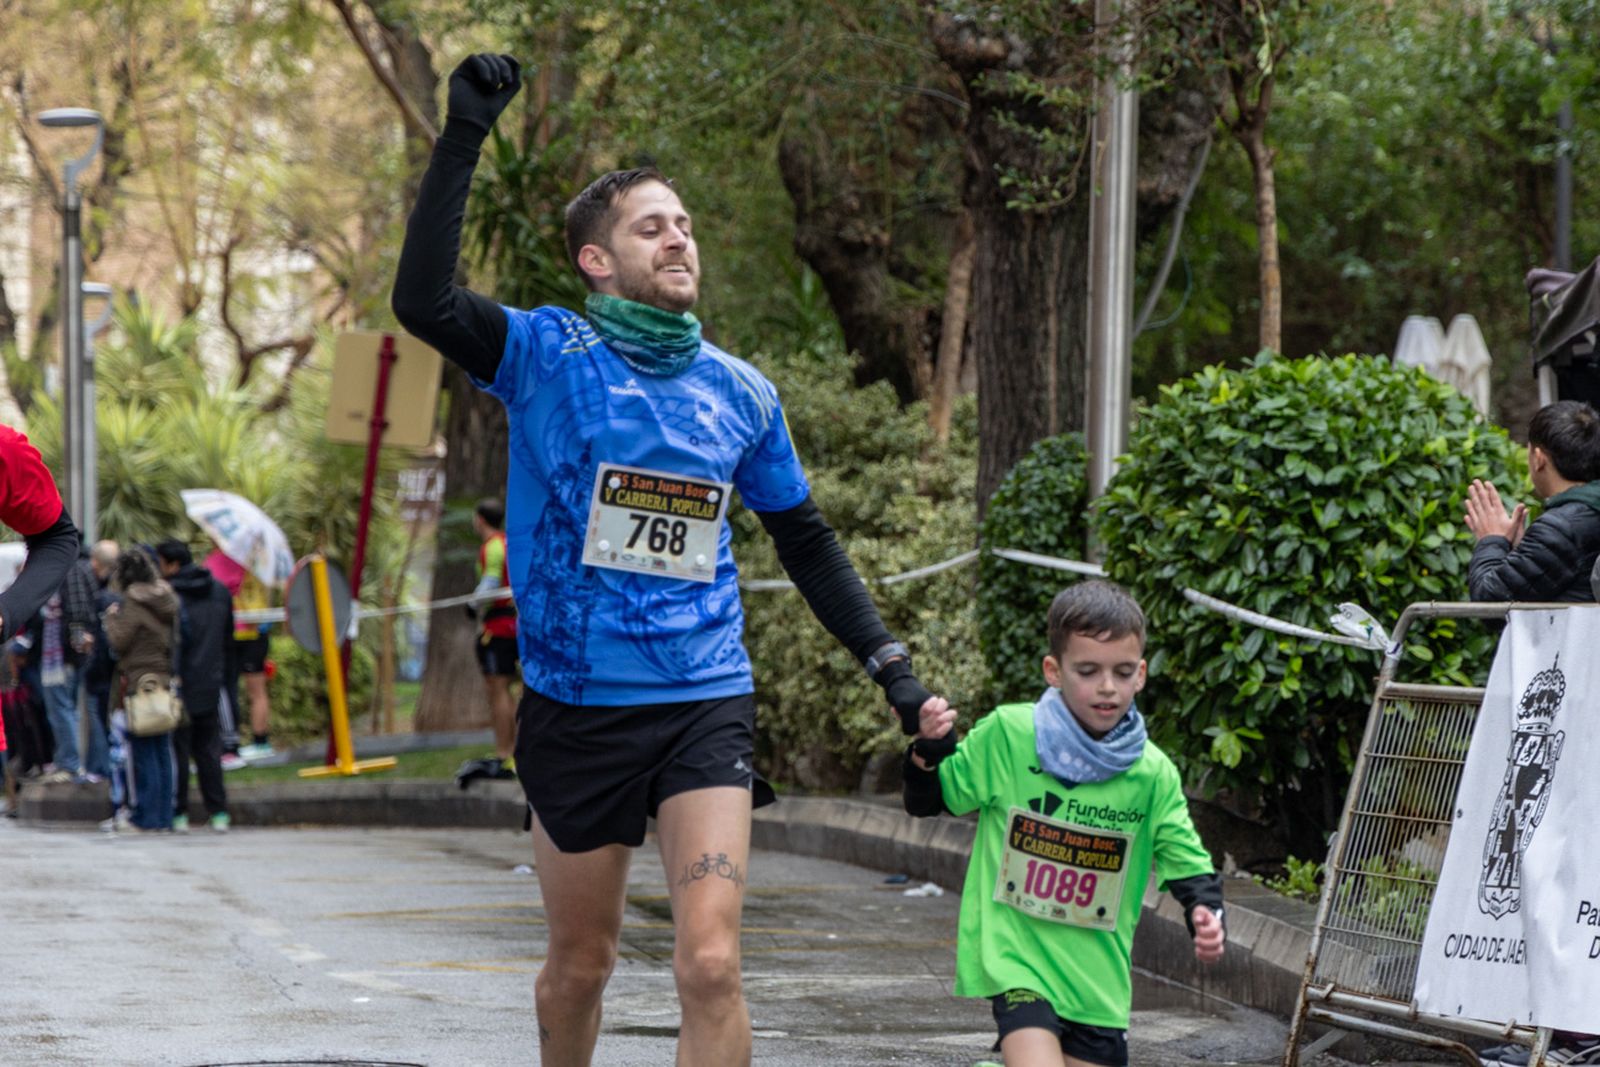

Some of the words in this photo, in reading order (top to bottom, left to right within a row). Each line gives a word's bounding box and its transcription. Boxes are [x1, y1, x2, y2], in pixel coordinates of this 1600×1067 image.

[632, 476, 654, 490] San
[657, 481, 683, 494] Juan
[685, 484, 714, 499] Bosc
[605, 488, 613, 501] V
[617, 490, 668, 510] CARRERA
[672, 499, 716, 517] POPULAR
[625, 513, 688, 556] 768
[1014, 832, 1021, 846] V
[1023, 836, 1073, 862] CARRERA
[1076, 850, 1120, 870] POPULAR
[1039, 825, 1060, 840] San
[1063, 833, 1091, 848] Juan
[1092, 838, 1118, 852] Bosc
[1024, 859, 1098, 908] 1089
[1486, 937, 1505, 962] DE
